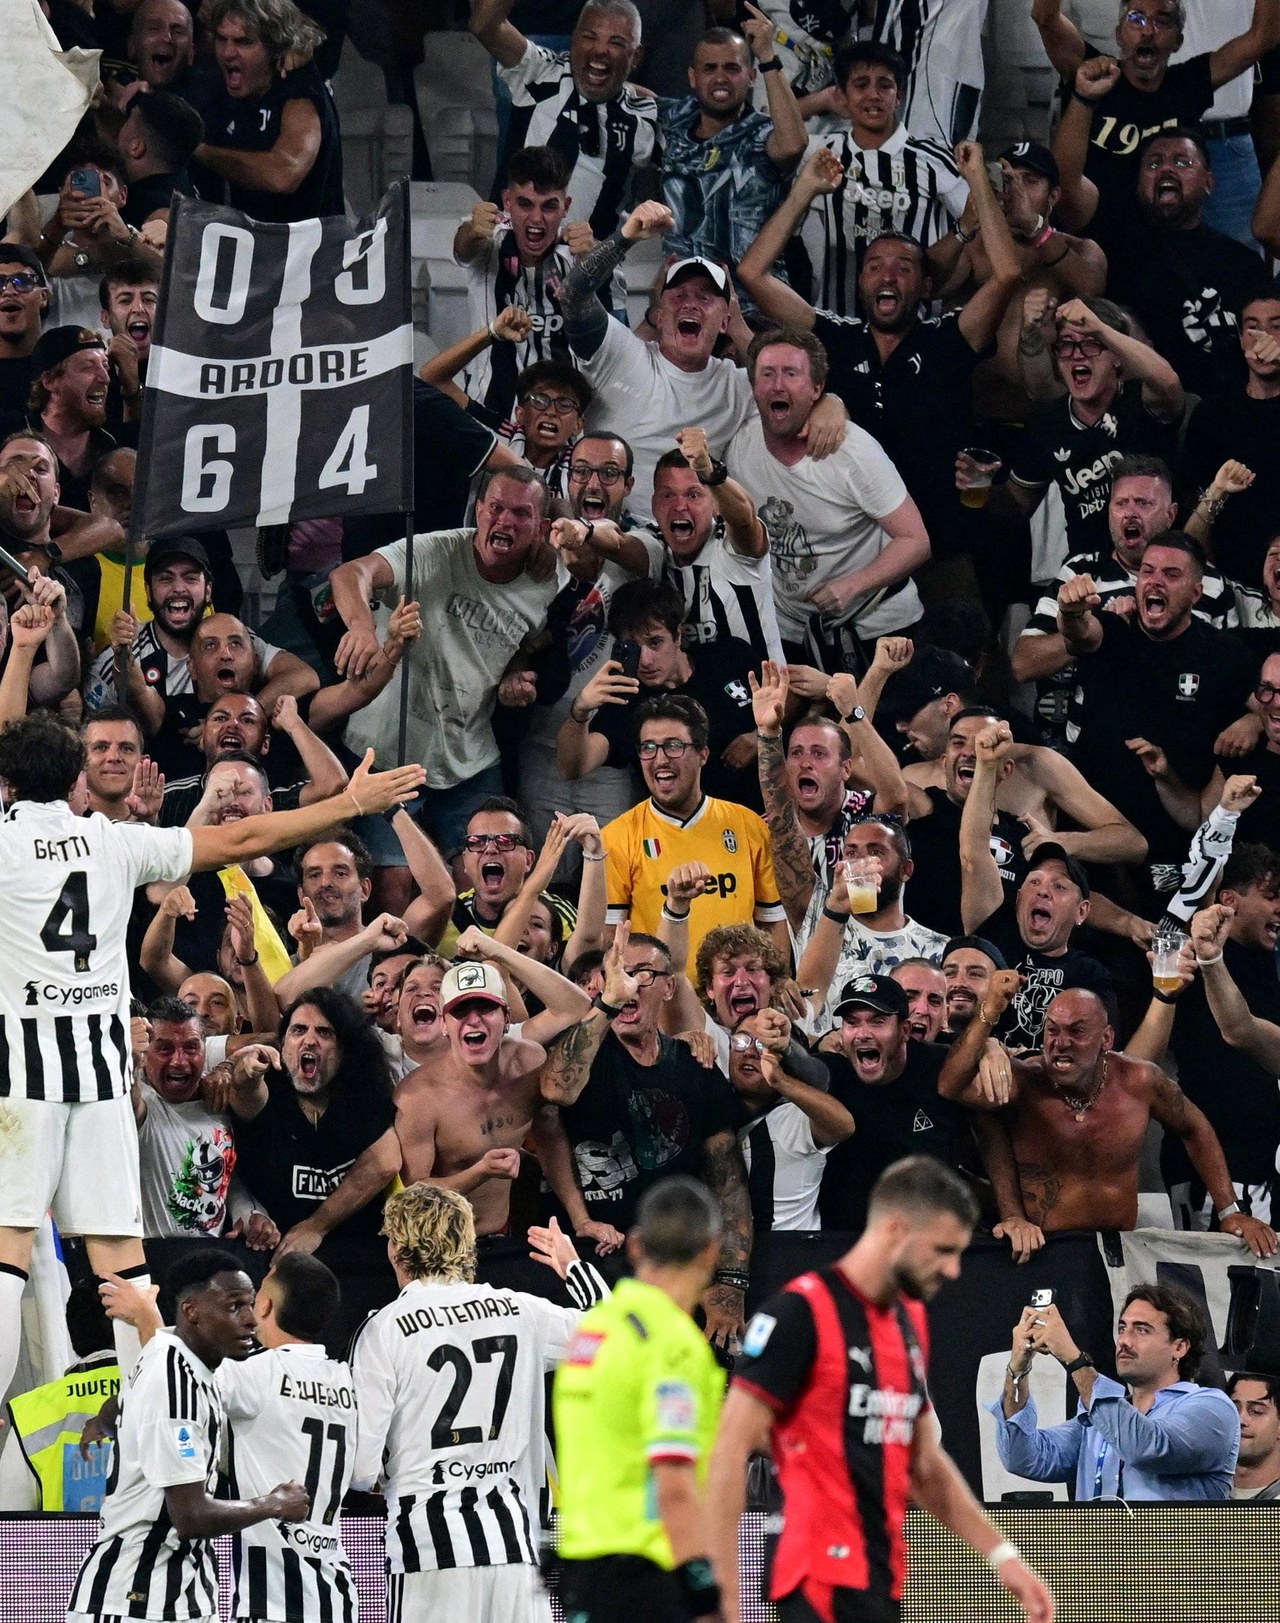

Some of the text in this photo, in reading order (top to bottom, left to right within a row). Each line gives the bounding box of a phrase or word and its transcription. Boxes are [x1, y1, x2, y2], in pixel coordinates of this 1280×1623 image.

[199, 346, 369, 395] ARDORE
[179, 403, 378, 513] 6 4
[1083, 482, 1110, 500] VISIT
[34, 835, 91, 862] GATTI
[39, 871, 98, 973] 4
[43, 982, 119, 1005] Cygames
[66, 1378, 120, 1398] JUVEN
[427, 1334, 518, 1450] 27
[301, 1416, 346, 1526] 11
